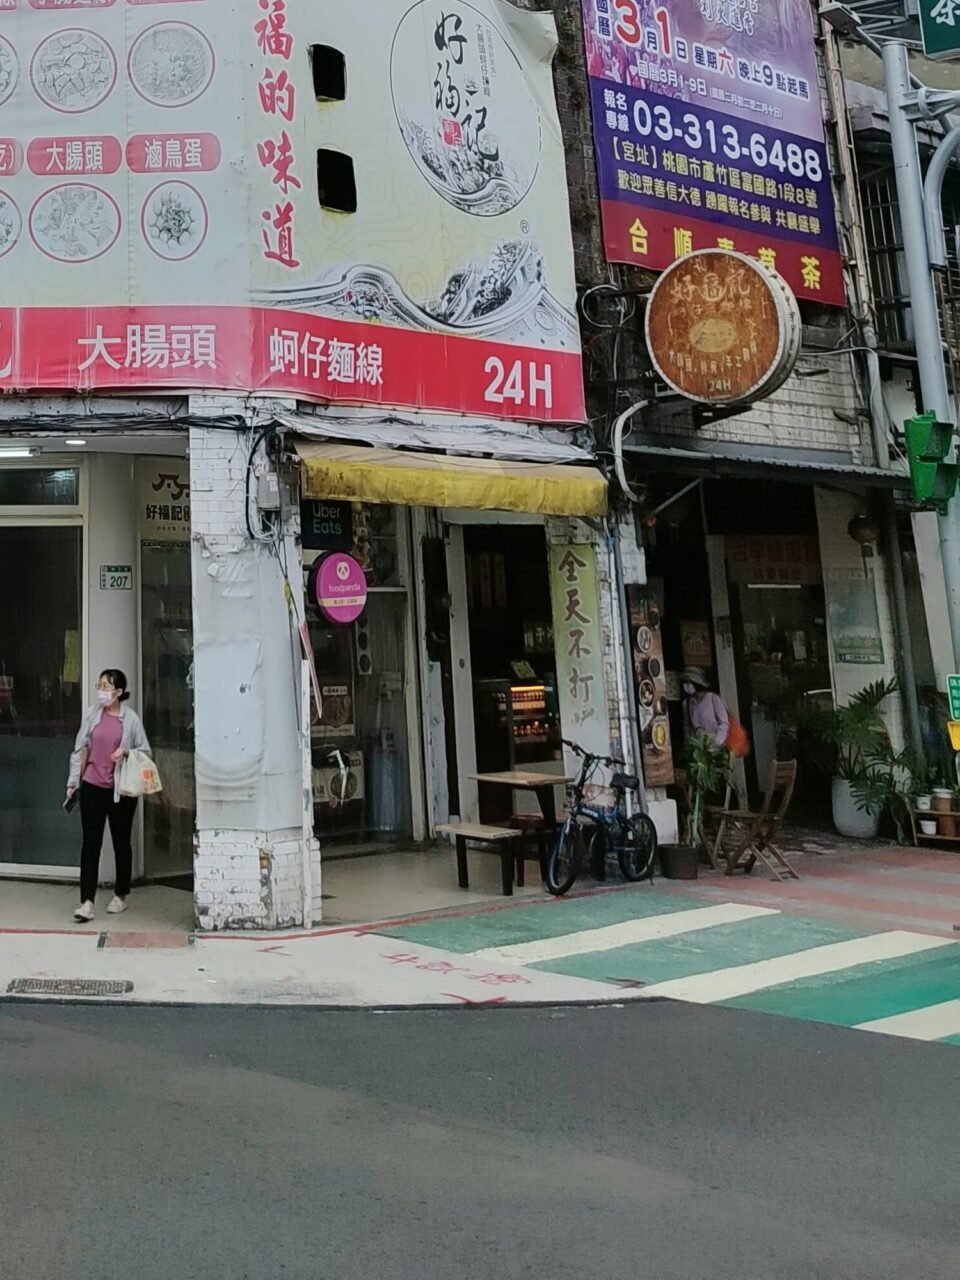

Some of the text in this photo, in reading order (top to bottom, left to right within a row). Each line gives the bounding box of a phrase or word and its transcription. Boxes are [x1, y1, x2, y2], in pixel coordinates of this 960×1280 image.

[604, 88, 628, 111] 報名
[144, 138, 202, 170] 滷鳥蛋
[633, 99, 823, 182] 03-313-6488
[46, 140, 104, 171] 大腸頭
[77, 324, 218, 372] 大腸頭
[269, 327, 384, 386] 蚵仔麵線
[484, 356, 553, 409] 24H
[709, 380, 732, 392] 24H
[312, 503, 341, 518] Uber
[313, 519, 342, 535] Eats
[110, 576, 128, 588] 207
[329, 583, 361, 595] foodpanda
